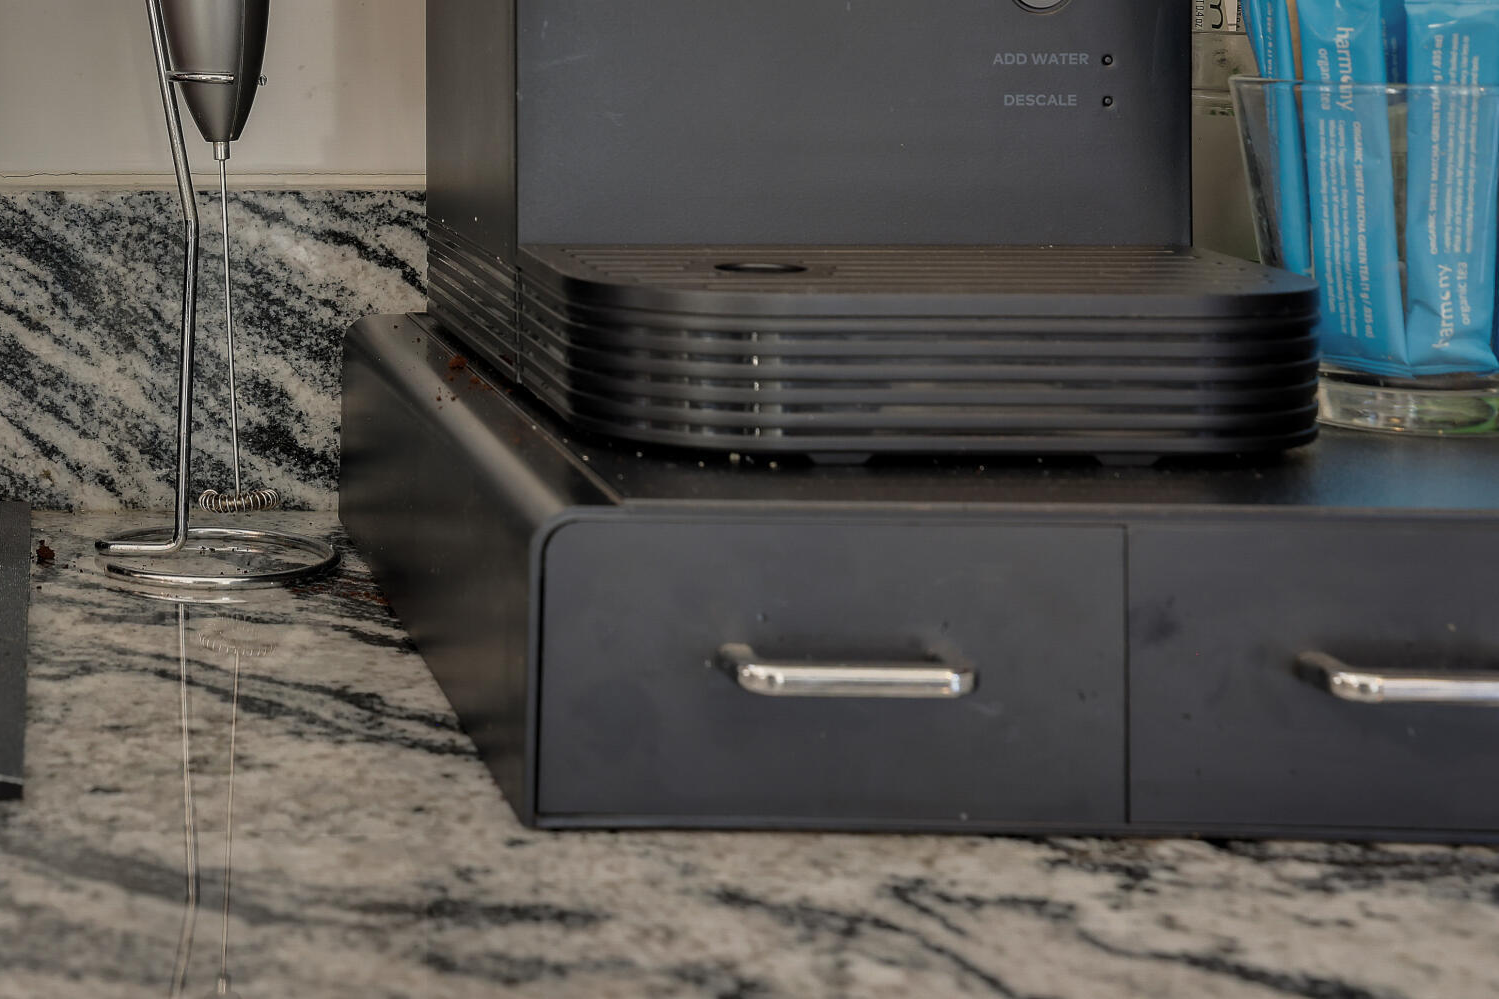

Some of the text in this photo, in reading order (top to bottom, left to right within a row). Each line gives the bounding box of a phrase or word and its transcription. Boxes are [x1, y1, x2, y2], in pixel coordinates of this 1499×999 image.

[993, 53, 1090, 65] ADD WATER
[1003, 94, 1077, 106] DESCALE
